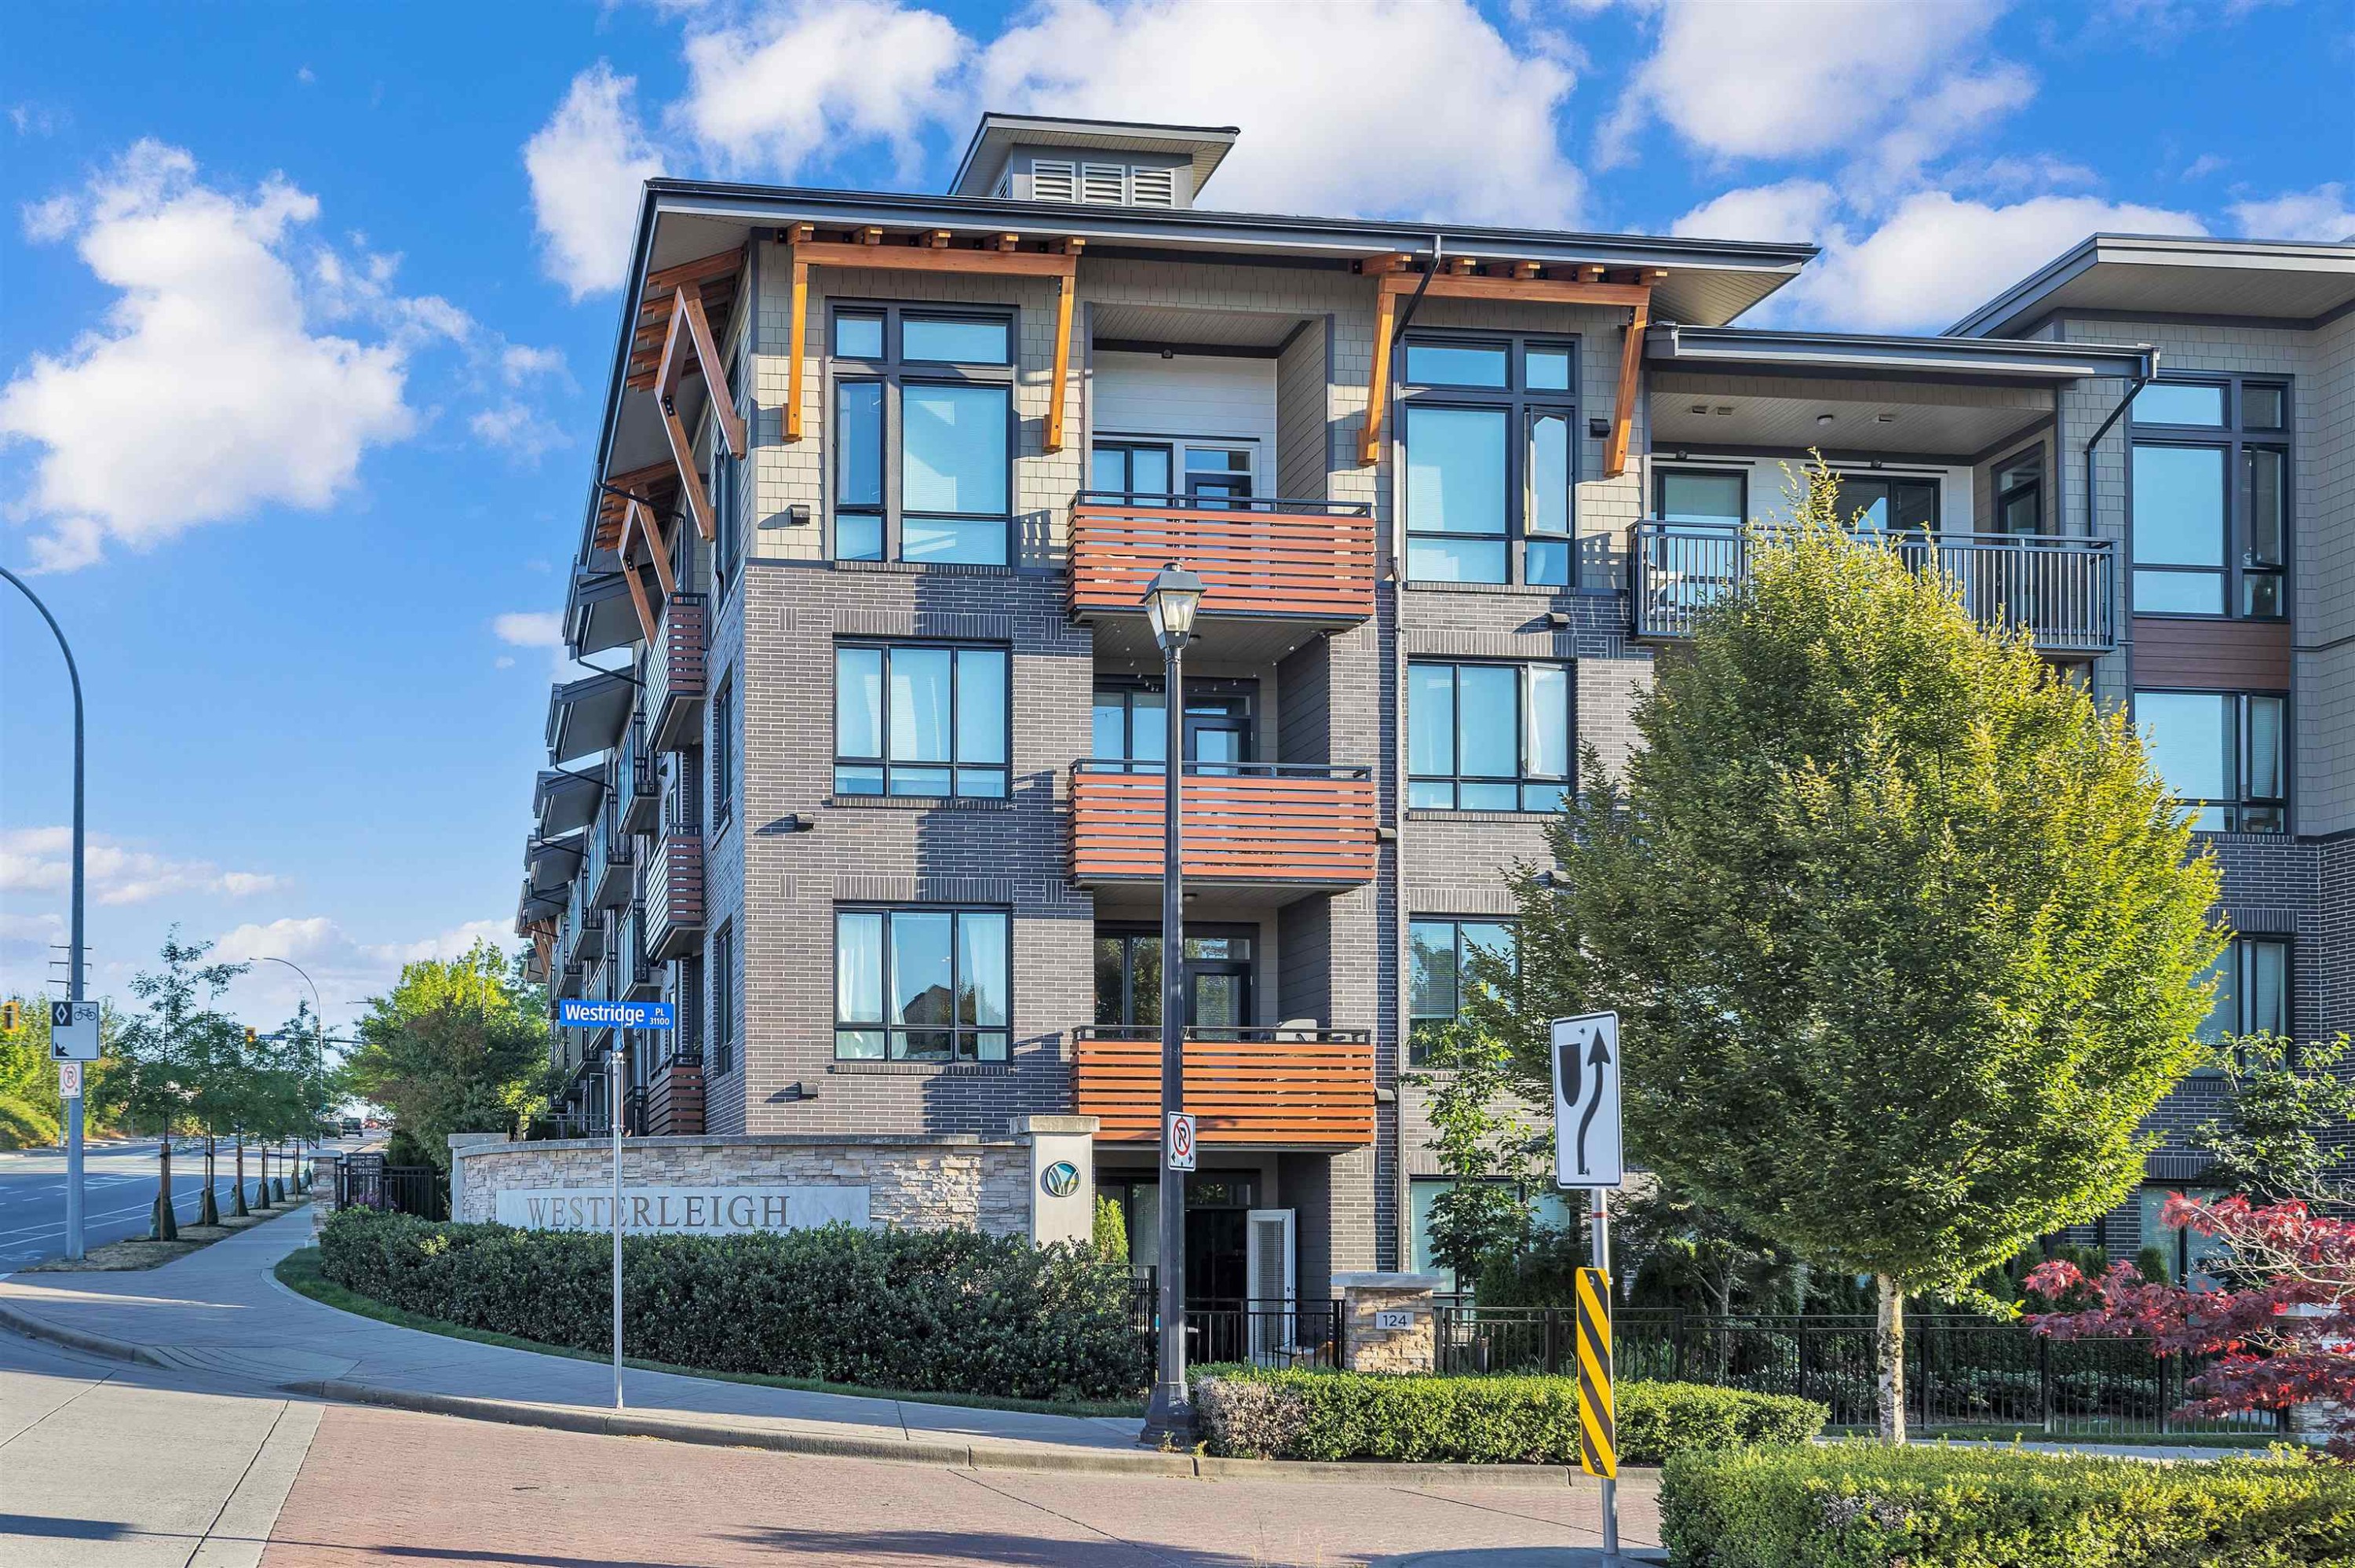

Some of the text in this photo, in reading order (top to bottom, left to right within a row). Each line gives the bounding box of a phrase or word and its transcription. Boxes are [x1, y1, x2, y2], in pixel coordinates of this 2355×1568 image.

[565, 1005, 664, 1026] Westridge PL
[1382, 1315, 1408, 1327] 124
